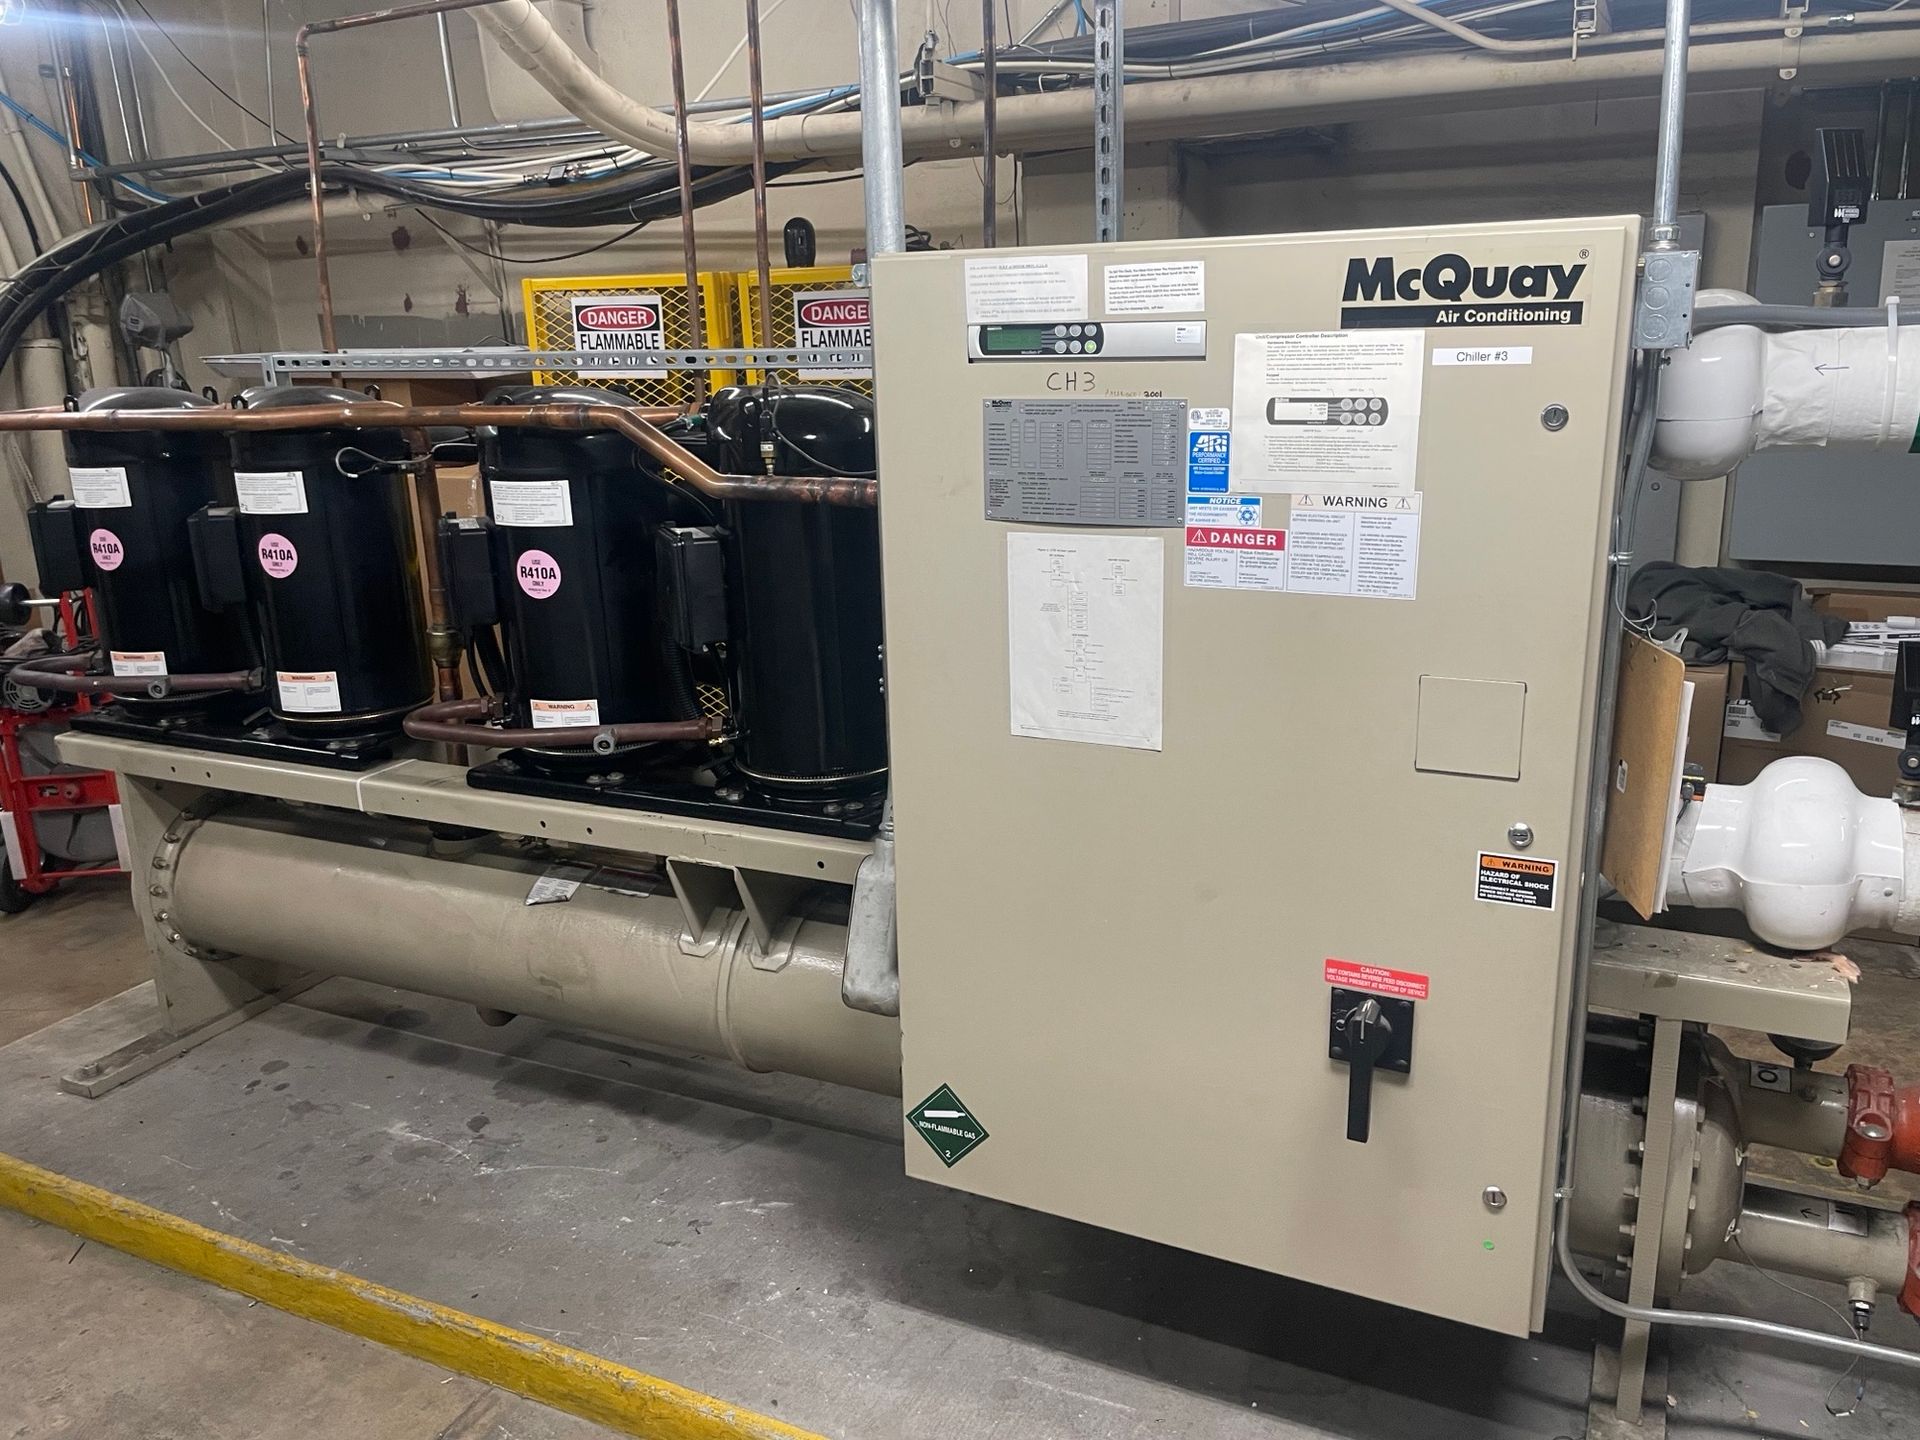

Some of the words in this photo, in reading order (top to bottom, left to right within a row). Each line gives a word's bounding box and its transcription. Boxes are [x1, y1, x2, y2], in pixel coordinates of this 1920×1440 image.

[1342, 253, 1587, 302] McQuay
[587, 310, 648, 325] DANGER
[811, 304, 870, 321] DANGE
[1436, 310, 1460, 323] Air
[1464, 308, 1571, 323] Conditioning
[580, 332, 660, 350] FLAMMABLE
[1456, 351, 1492, 362] Chiller
[1494, 350, 1508, 362] #3
[1046, 371, 1096, 392] CH3
[1143, 390, 1163, 398] 2001
[1209, 497, 1242, 505] NOTICE
[1322, 495, 1389, 509] WARNING
[1210, 531, 1277, 546] DANGER
[92, 542, 120, 554] R410A
[261, 548, 294, 560] R410A
[520, 565, 557, 580] R410A
[1502, 860, 1550, 873] WARNING
[1480, 869, 1509, 879] HAZARD
[1480, 875, 1523, 887] ELECTRICAL
[1524, 881, 1550, 890] SHOCK
[1360, 966, 1392, 977] CAUTION:
[919, 1120, 963, 1137] NON-FLAMMABLE
[963, 1130, 976, 1140] GAS
[945, 1149, 951, 1158] 2
